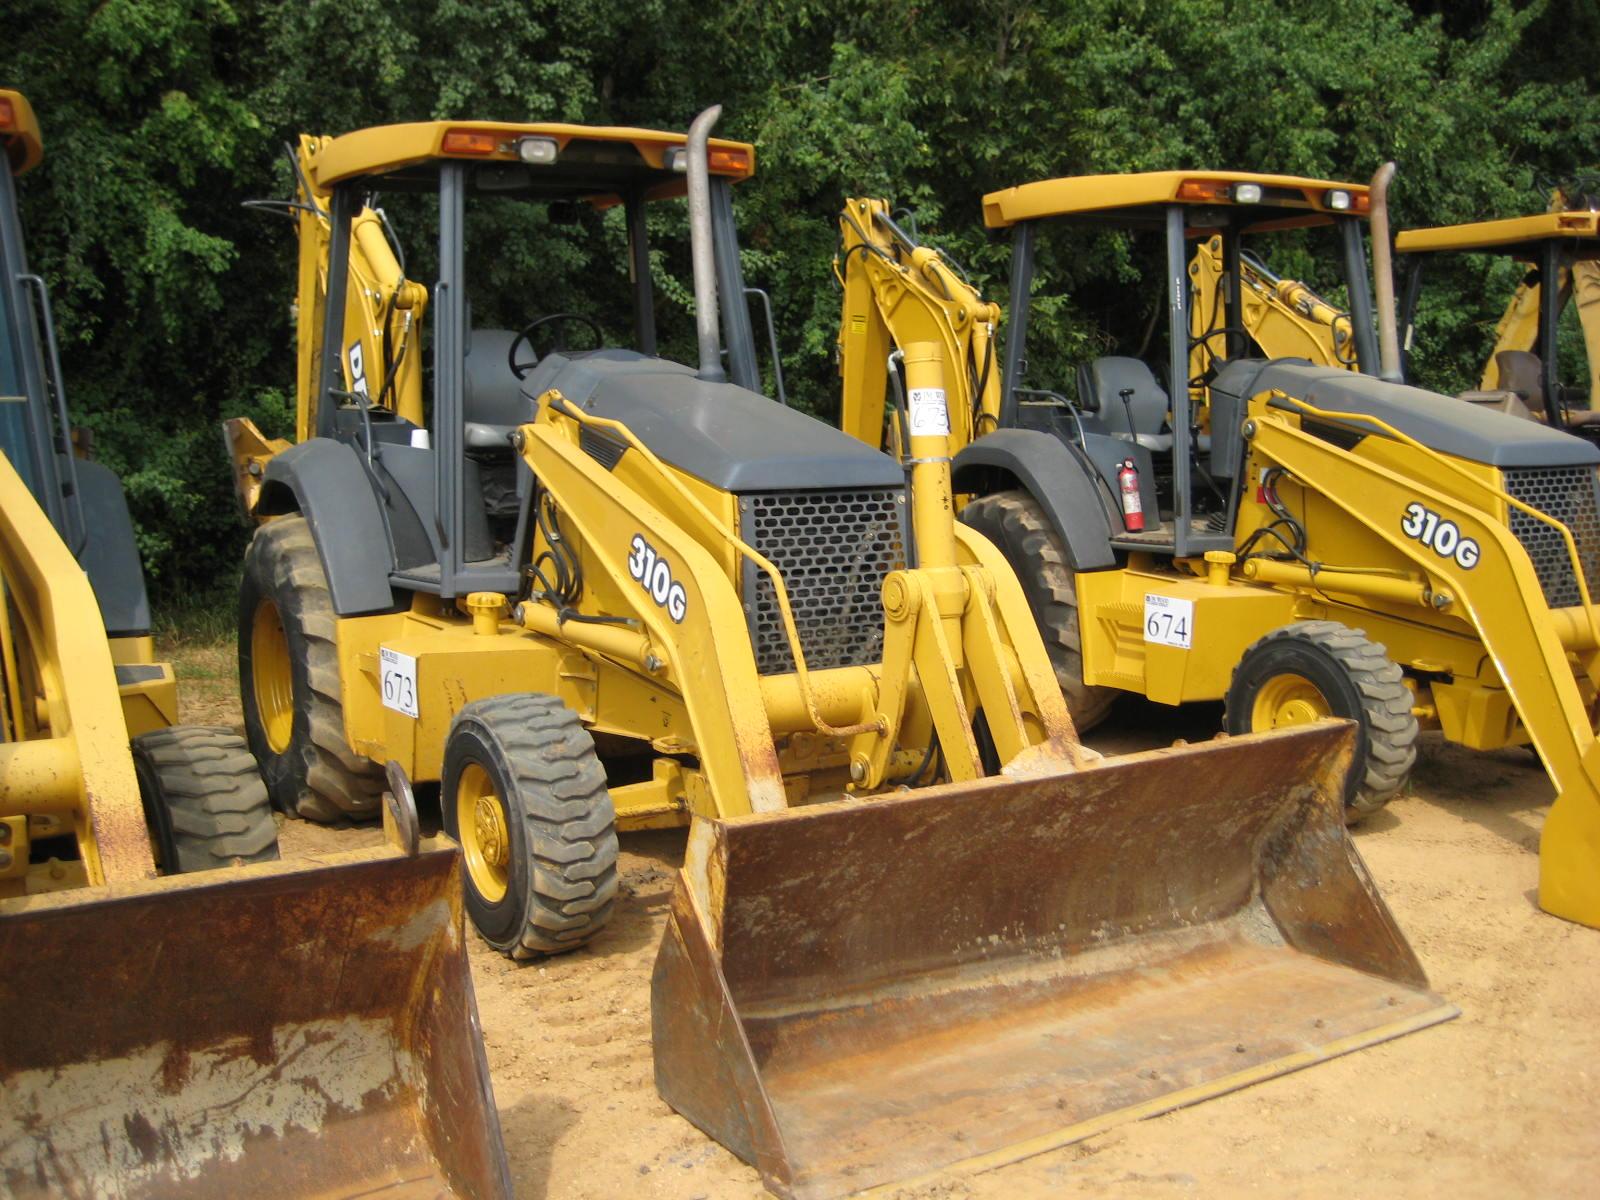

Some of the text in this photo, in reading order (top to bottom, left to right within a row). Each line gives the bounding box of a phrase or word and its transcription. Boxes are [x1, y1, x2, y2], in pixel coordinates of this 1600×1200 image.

[1401, 502, 1480, 570] 310G
[628, 533, 687, 624] 310G
[1147, 611, 1188, 642] 674
[384, 670, 413, 708] 673
